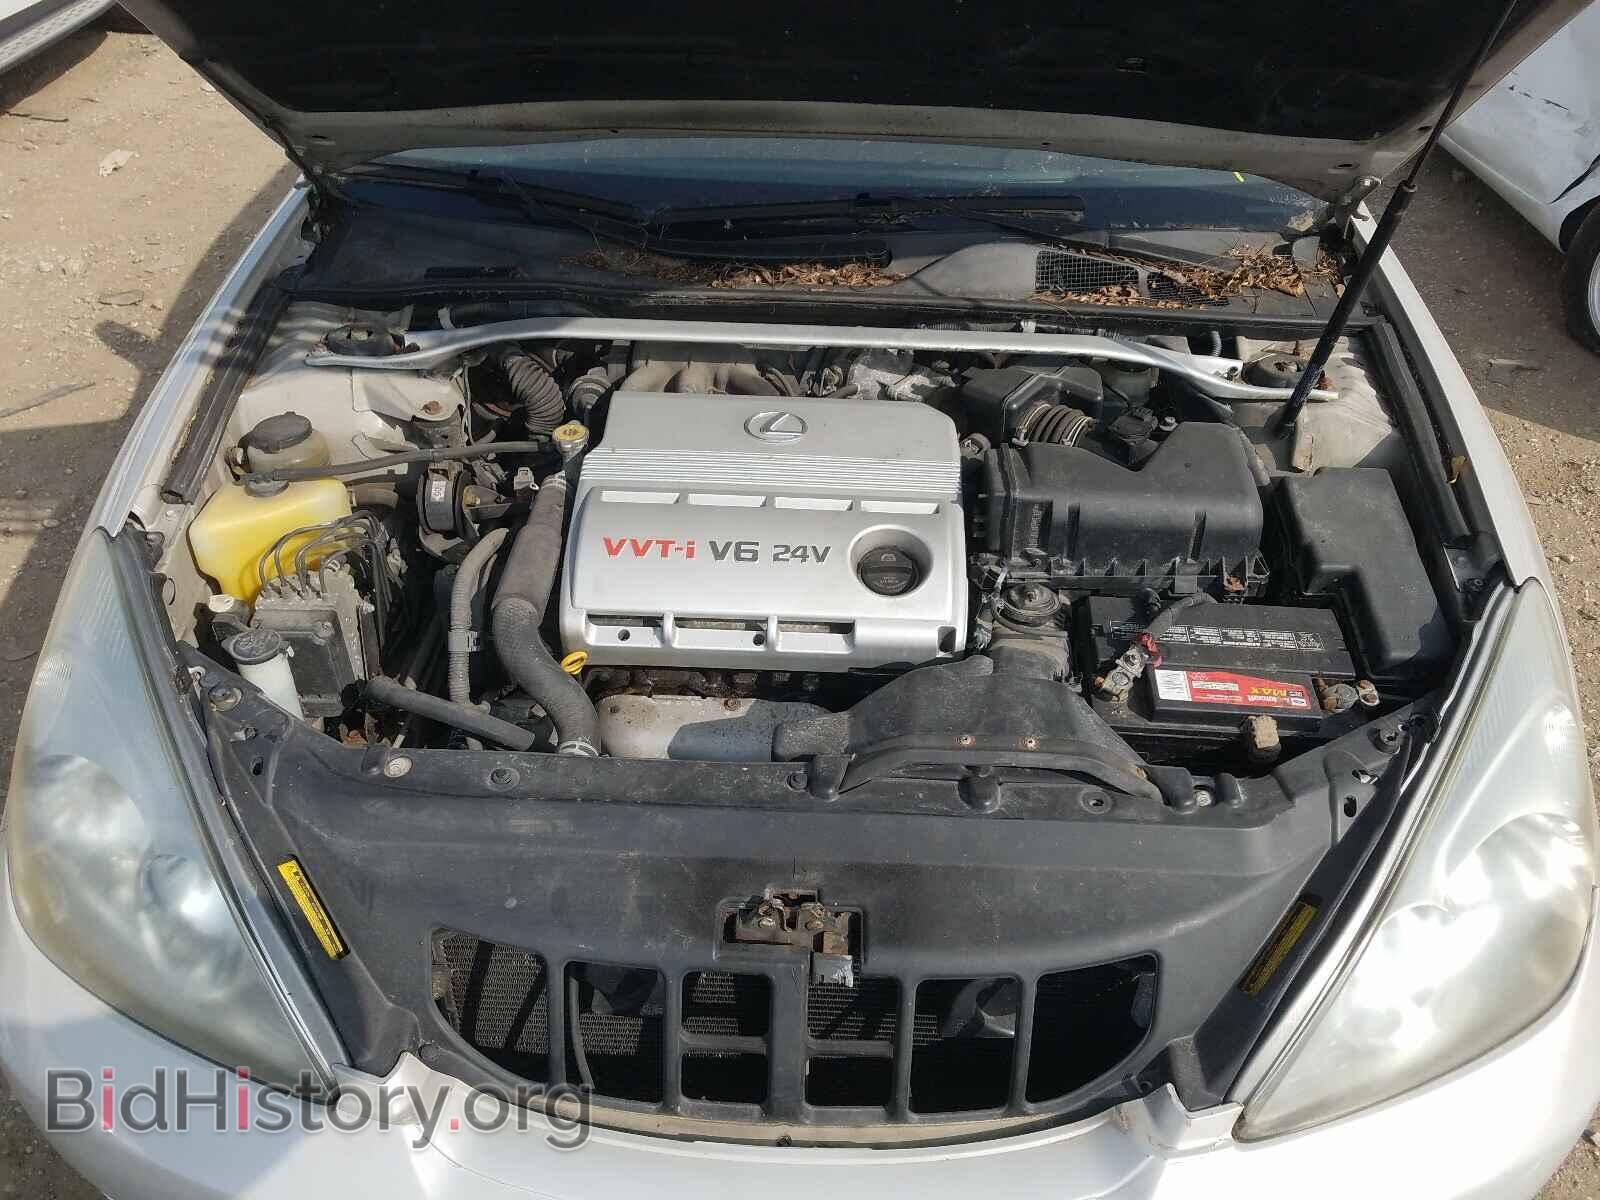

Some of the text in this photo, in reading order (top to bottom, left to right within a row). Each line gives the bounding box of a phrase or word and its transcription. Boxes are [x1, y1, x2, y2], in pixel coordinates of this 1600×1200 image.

[602, 537, 832, 563] VVT-i V6 24V
[1251, 686, 1288, 697] MAX
